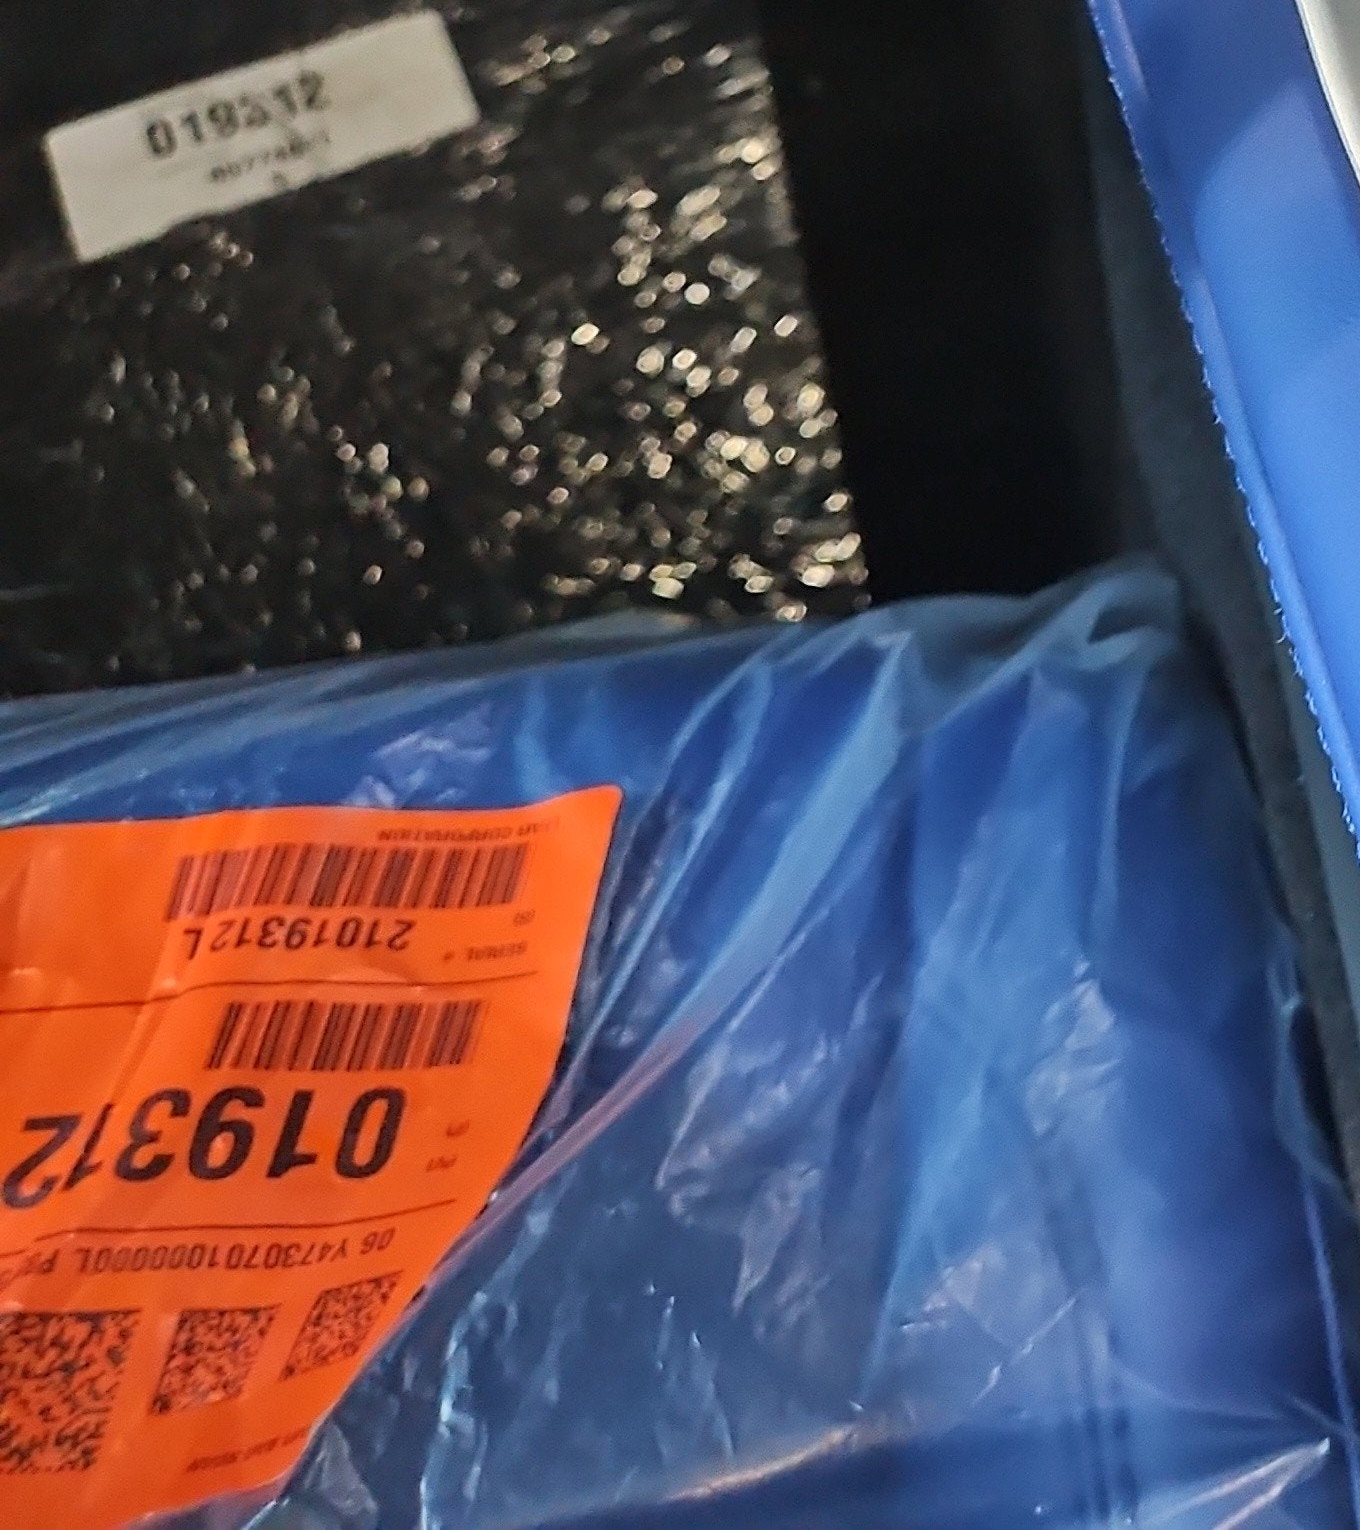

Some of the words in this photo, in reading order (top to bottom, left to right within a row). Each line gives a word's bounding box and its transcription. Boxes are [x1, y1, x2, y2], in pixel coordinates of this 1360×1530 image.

[183, 927, 203, 960] L
[211, 916, 416, 952] 21019312
[2, 1087, 407, 1210] 019312
[360, 1228, 396, 1255] 06
